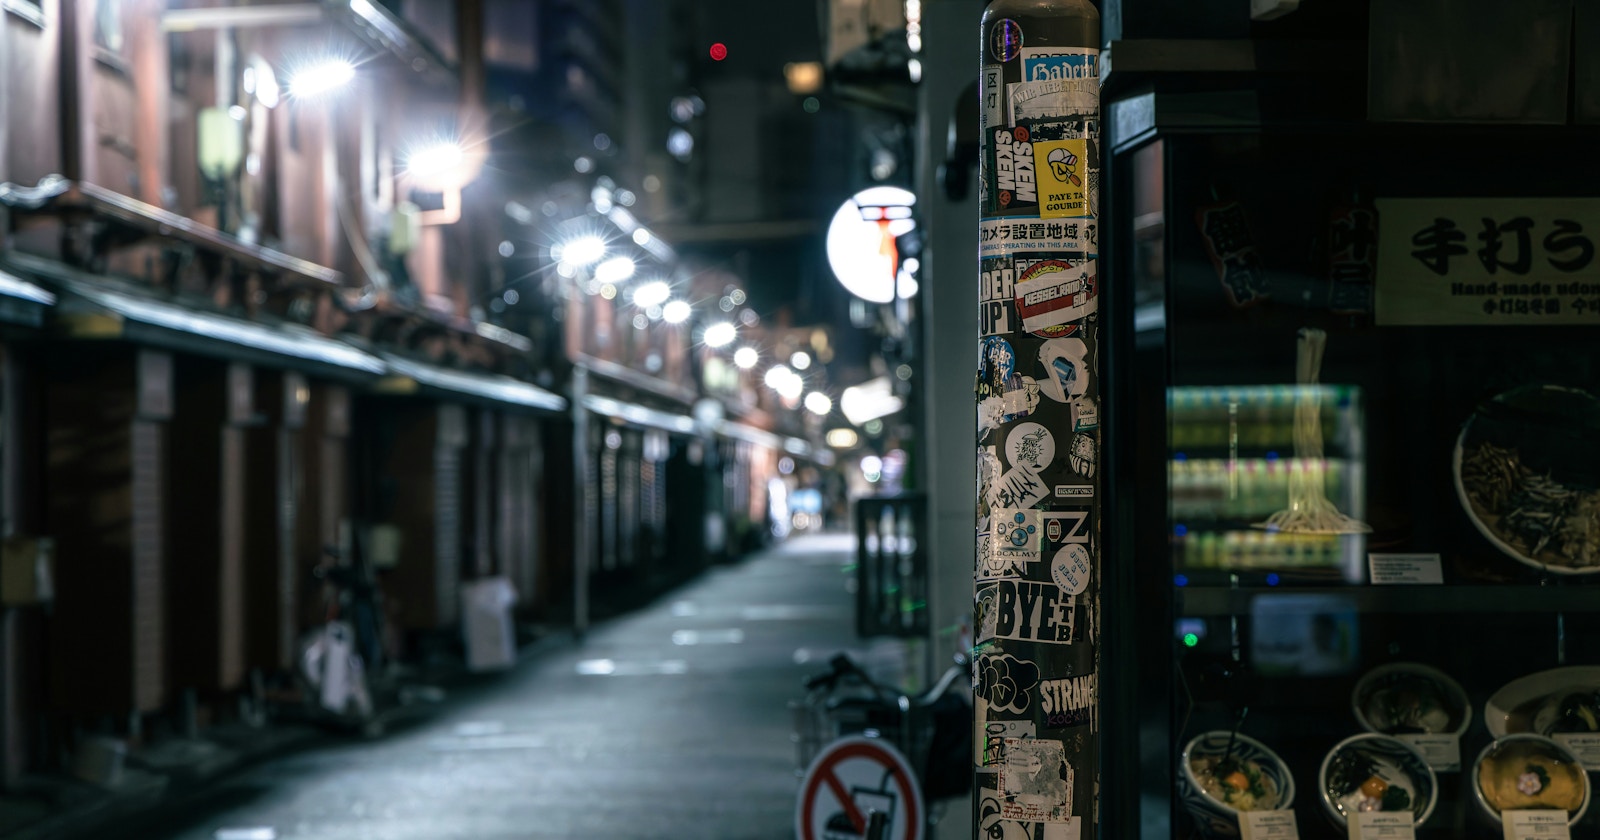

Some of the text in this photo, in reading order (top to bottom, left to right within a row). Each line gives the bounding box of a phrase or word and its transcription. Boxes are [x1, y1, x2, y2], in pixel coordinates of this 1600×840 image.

[995, 129, 1016, 191] SKEM
[1046, 201, 1083, 211] GOURDE
[1048, 192, 1084, 202] PAYE TA
[981, 223, 1078, 242] カメラ設置地域
[1411, 215, 1595, 275] 手打う
[1024, 279, 1081, 307] KESSELRAND
[1451, 281, 1551, 296] Hand-made
[996, 581, 1059, 641] BYE
